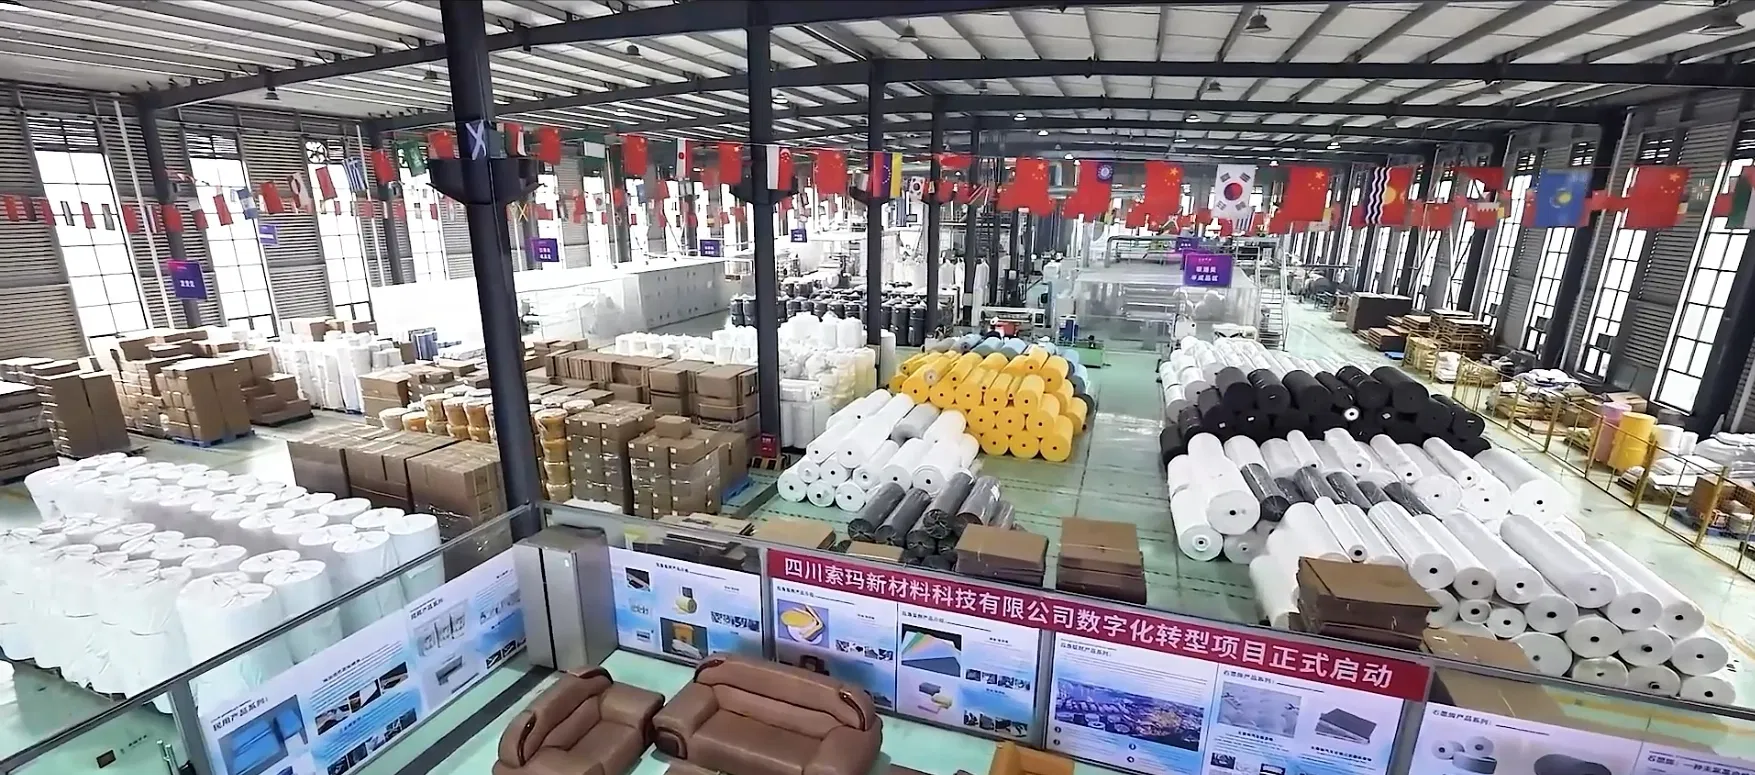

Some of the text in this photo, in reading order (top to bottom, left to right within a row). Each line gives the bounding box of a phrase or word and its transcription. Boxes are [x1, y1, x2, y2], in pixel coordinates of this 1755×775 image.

[784, 557, 1393, 688] 四川索玛新材料科技有限公司数字化转型项目正式启动
